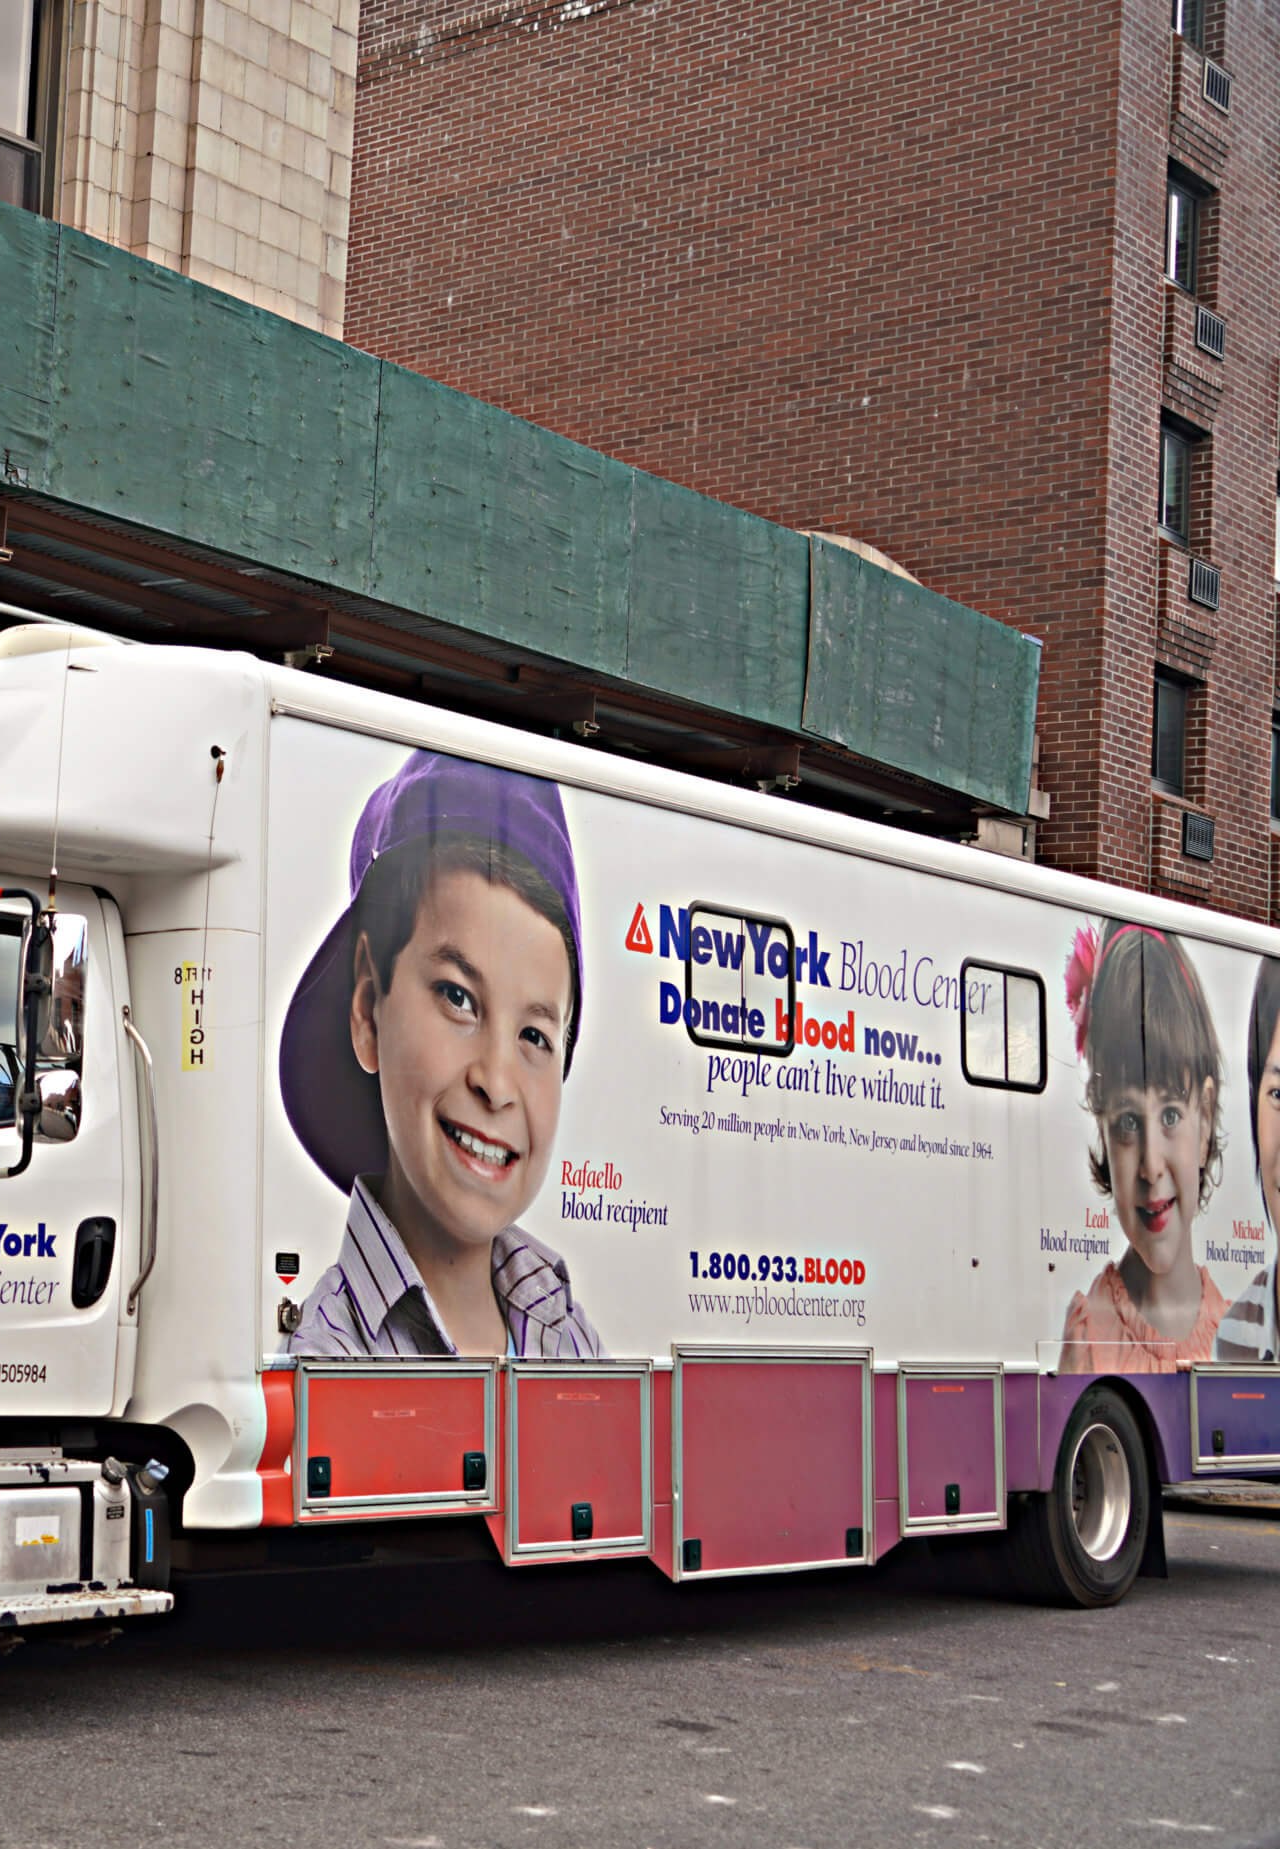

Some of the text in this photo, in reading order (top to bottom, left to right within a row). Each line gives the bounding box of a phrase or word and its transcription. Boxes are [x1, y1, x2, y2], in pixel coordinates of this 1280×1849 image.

[659, 903, 746, 970] New
[745, 919, 831, 988] York
[838, 940, 908, 1002] Blood
[659, 981, 942, 1065] Donate blood now...
[706, 1049, 945, 1110] people can't live without it.
[659, 1105, 994, 1160] Serving 20 million people in New York, New Jersey and beyond since 1964.
[561, 1160, 623, 1195] Rafaello
[561, 1191, 669, 1232] blood recipient
[1085, 1208, 1110, 1229] Leah
[1232, 1220, 1265, 1241] Michael
[1040, 1228, 1110, 1260] blood recipient
[1206, 1240, 1265, 1270] blood recipient
[689, 1251, 866, 1285] 1.800.933.BLOOD
[688, 1286, 867, 1327] www.nybloodcenter.org
